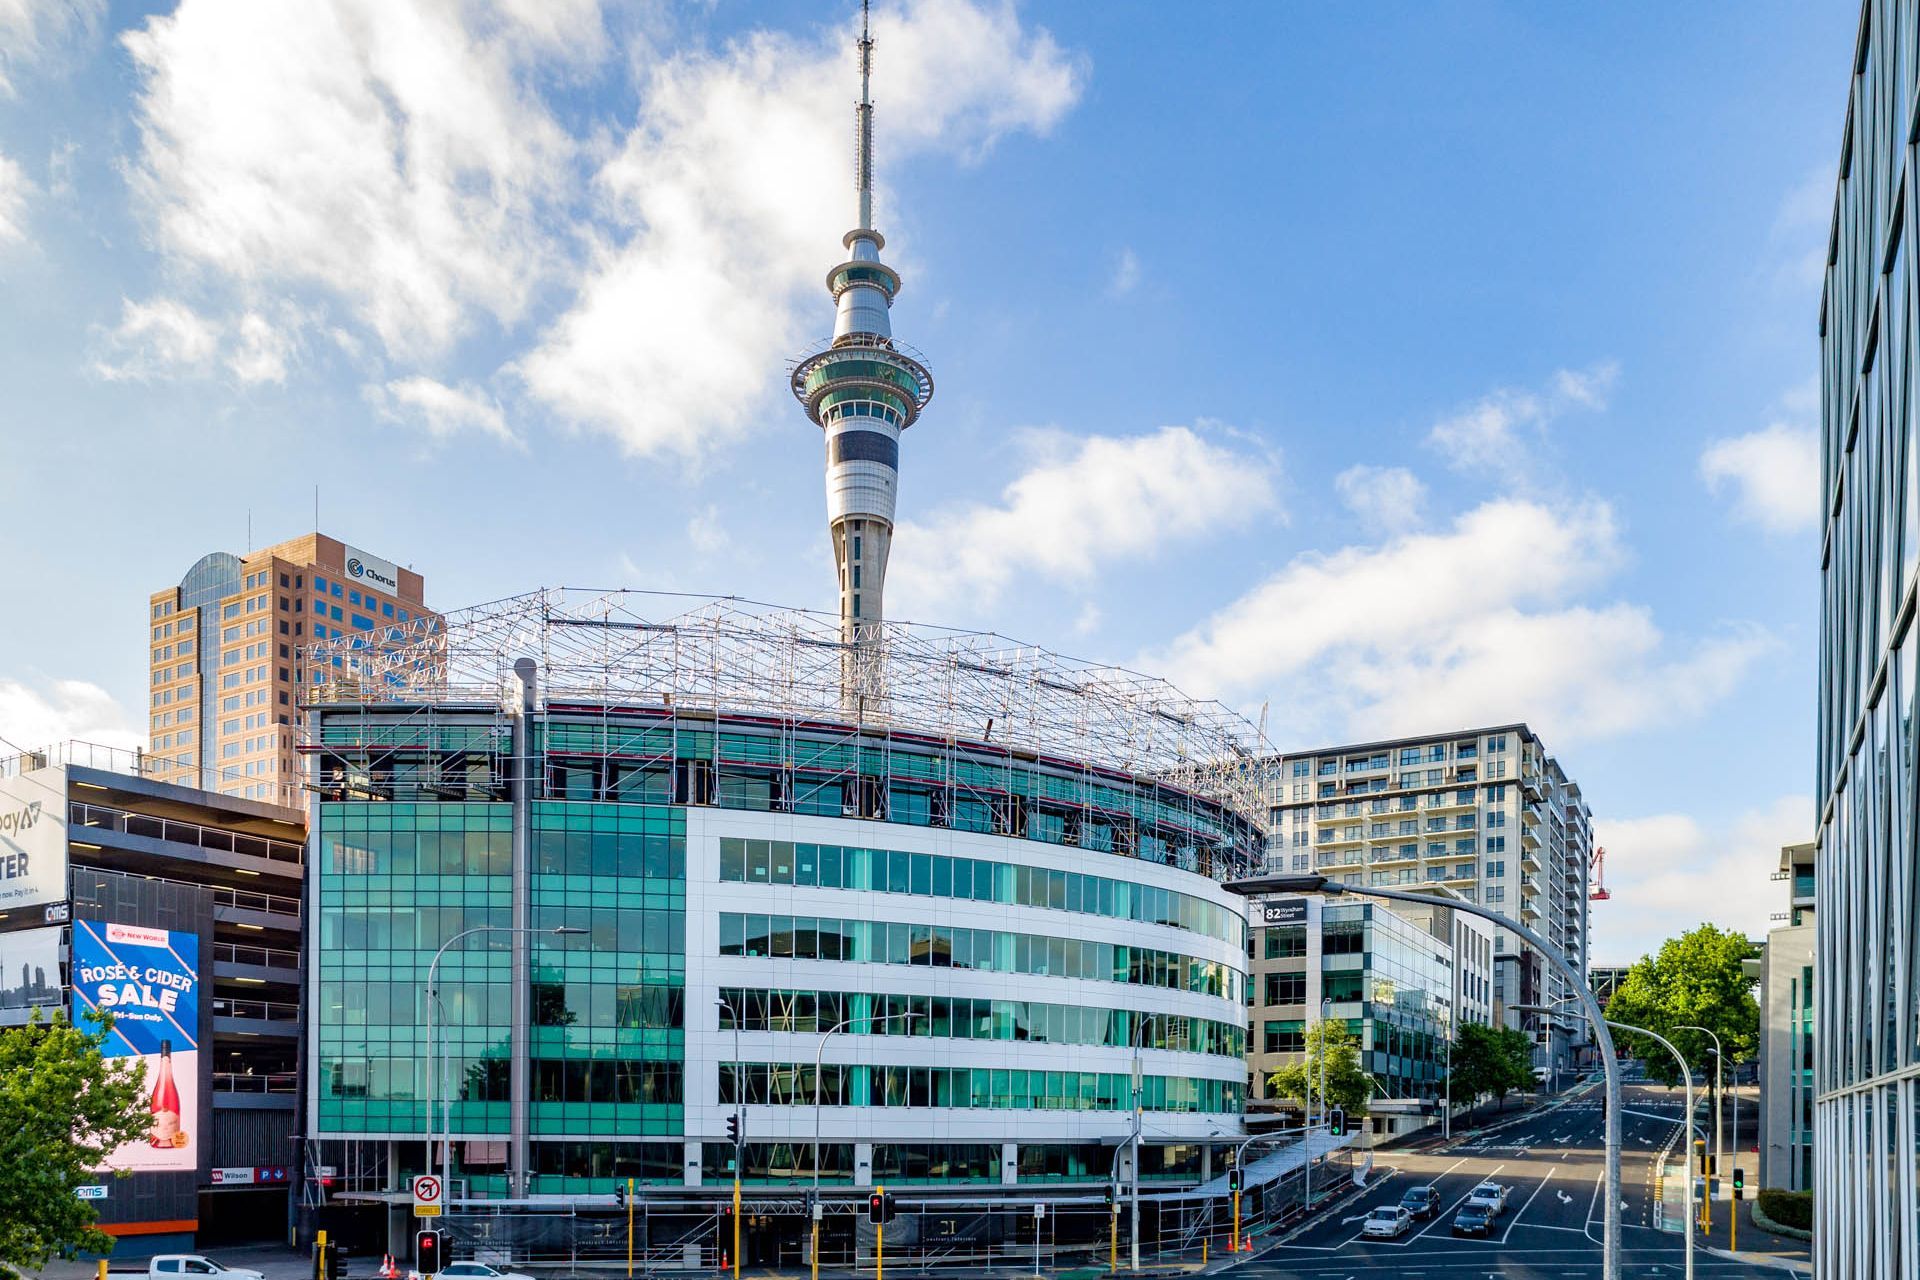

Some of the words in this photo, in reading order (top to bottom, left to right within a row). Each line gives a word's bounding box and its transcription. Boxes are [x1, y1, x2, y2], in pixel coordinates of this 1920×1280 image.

[366, 569, 396, 587] Chorus
[1266, 908, 1281, 919] 82
[81, 962, 127, 984] ROSÉ
[129, 966, 143, 980] &
[145, 968, 193, 993] CIDER
[97, 983, 179, 1012] SALE
[224, 1172, 248, 1180] Wilson
[261, 1169, 270, 1180] P
